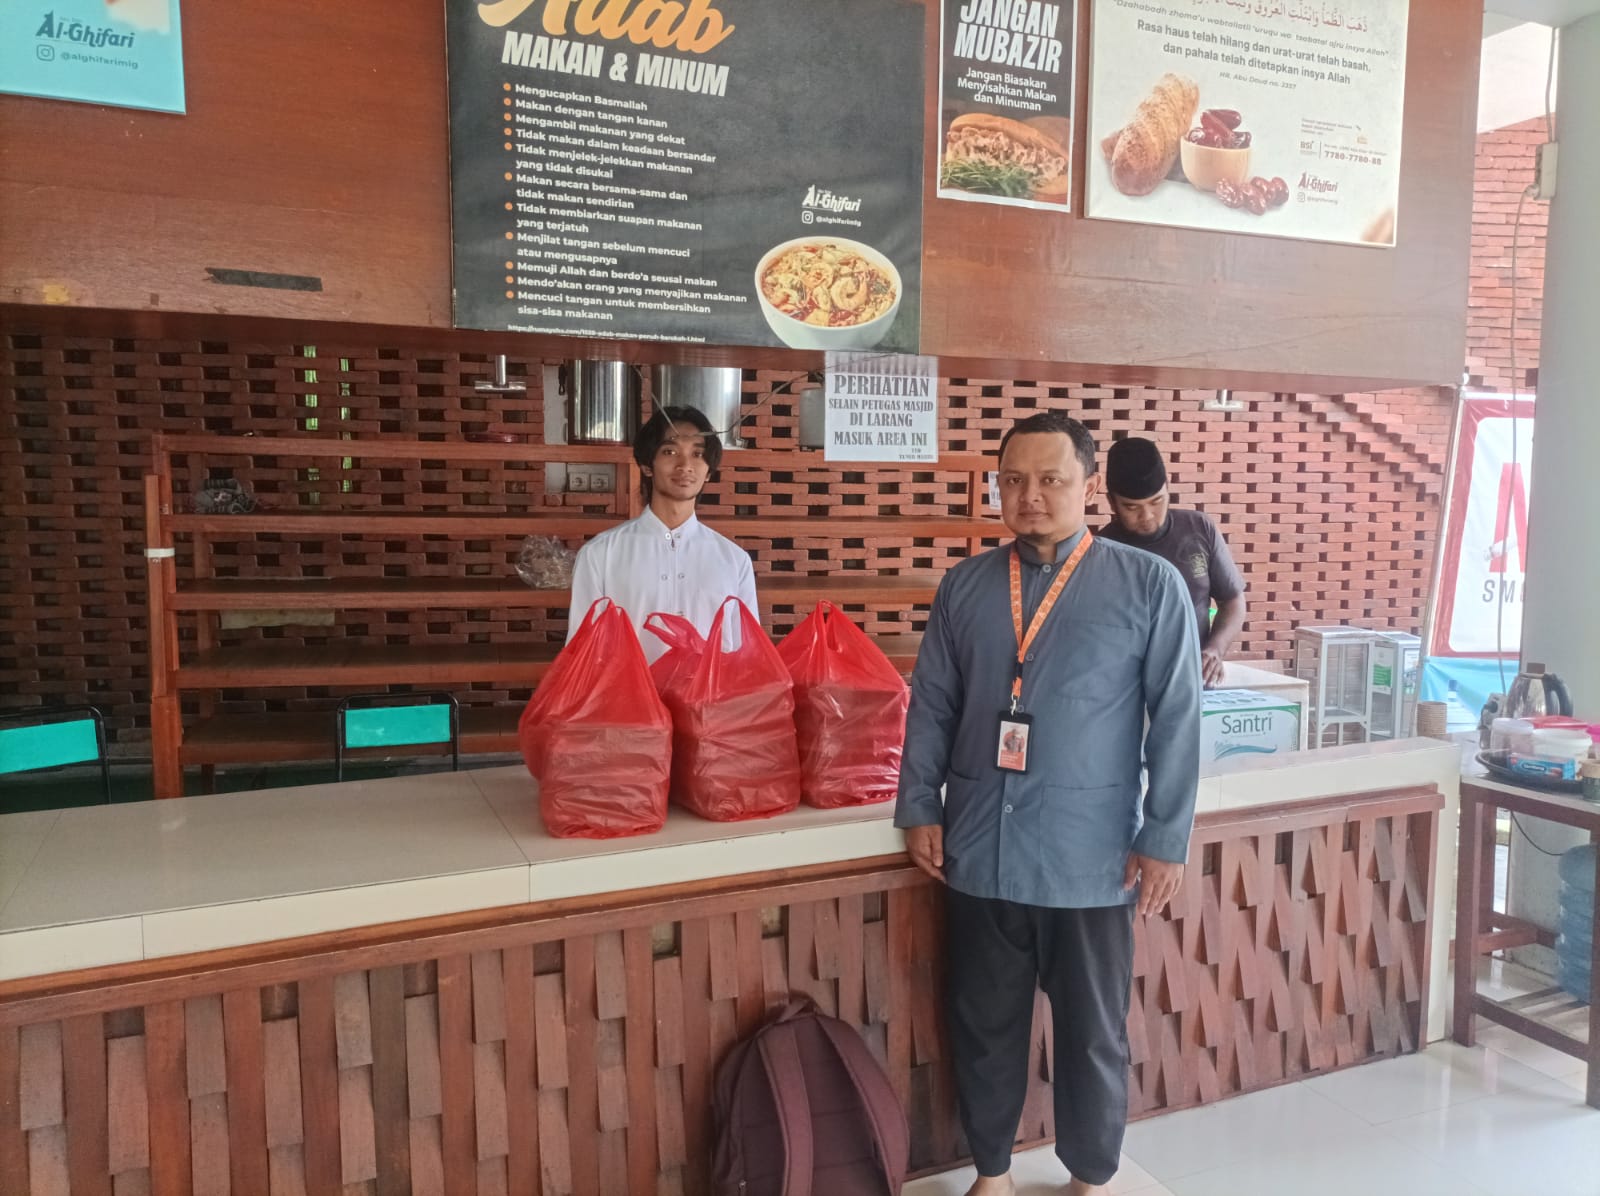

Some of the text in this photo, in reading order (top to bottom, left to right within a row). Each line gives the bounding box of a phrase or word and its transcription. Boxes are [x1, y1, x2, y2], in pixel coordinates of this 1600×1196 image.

[36, 10, 135, 48] Al-Ghifari
[960, 0, 1060, 38] JANGAN
[953, 22, 1063, 74] MUBAZIR
[1137, 19, 1371, 73] Rasa haus telah hilang dan urat-urat telah basah,
[501, 30, 730, 97] MAKAN & MINUM
[1163, 42, 1351, 84] dan pahala telah ditetapkan insya Allah
[957, 77, 1057, 103] Menyisahkan Makan
[966, 67, 1047, 89] Jangan Biasakan
[515, 84, 648, 111] Mengucapkan Basmallah
[974, 93, 1042, 111] dan Minuman
[515, 99, 668, 128] Makan dengan tangan kanan
[515, 113, 686, 145] Mengambil makanan yang dekat
[515, 129, 717, 163] Tidak makan dalam keadaan bersandar
[515, 144, 693, 174] Tidak menjelek-jelekkan makanan
[515, 160, 613, 178] yang tidak disukai
[516, 174, 688, 201] Makan secara bersama-sama dan
[1298, 172, 1339, 193] Al-Ghifari
[516, 188, 634, 209] tidak makan sendirian
[802, 184, 862, 212] Al-Ghifari
[516, 203, 702, 230] Tidak membiarkan suapan makanan
[516, 219, 589, 233] yang terjatuh
[517, 232, 690, 257] Menjilat tangan sebelum mencuci
[517, 248, 617, 265] atau mengusapnya
[517, 261, 717, 287] Memuji Allah dan berdo'a seusai makan
[517, 276, 747, 303] Mendo'akan orang yang menyajikan makanan
[517, 291, 711, 313] Mencuci tangan untuk membersihkan
[518, 305, 613, 320] sisa-sisa makanan
[833, 374, 930, 397] PERHATIAN
[829, 398, 934, 413] SELAIN PETUGAS MASJID
[849, 412, 913, 427] DI LARANG
[834, 431, 928, 446] MASUK AREA INI
[1482, 578, 1524, 603] SM
[1221, 712, 1273, 735] Santri
